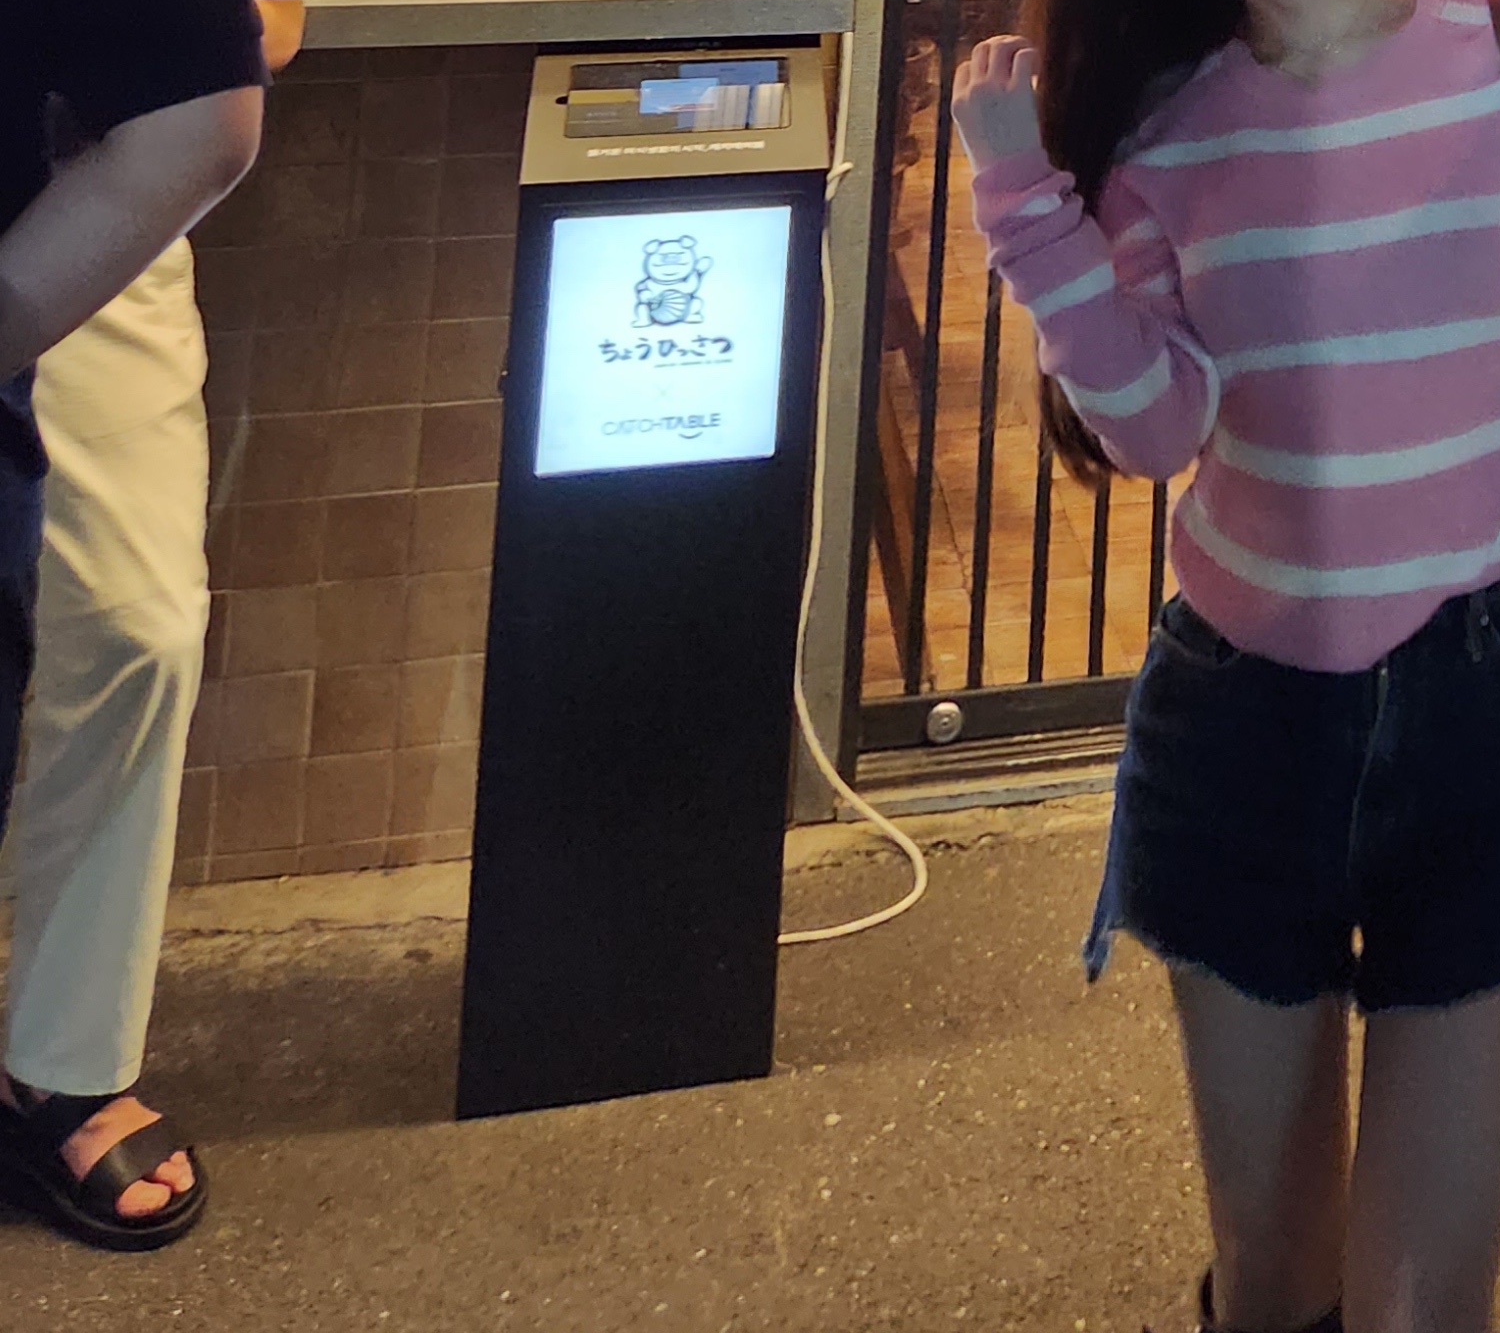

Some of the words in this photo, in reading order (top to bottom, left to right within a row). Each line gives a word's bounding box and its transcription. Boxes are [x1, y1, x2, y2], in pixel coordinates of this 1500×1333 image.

[598, 335, 735, 363] ちょうひっさつ
